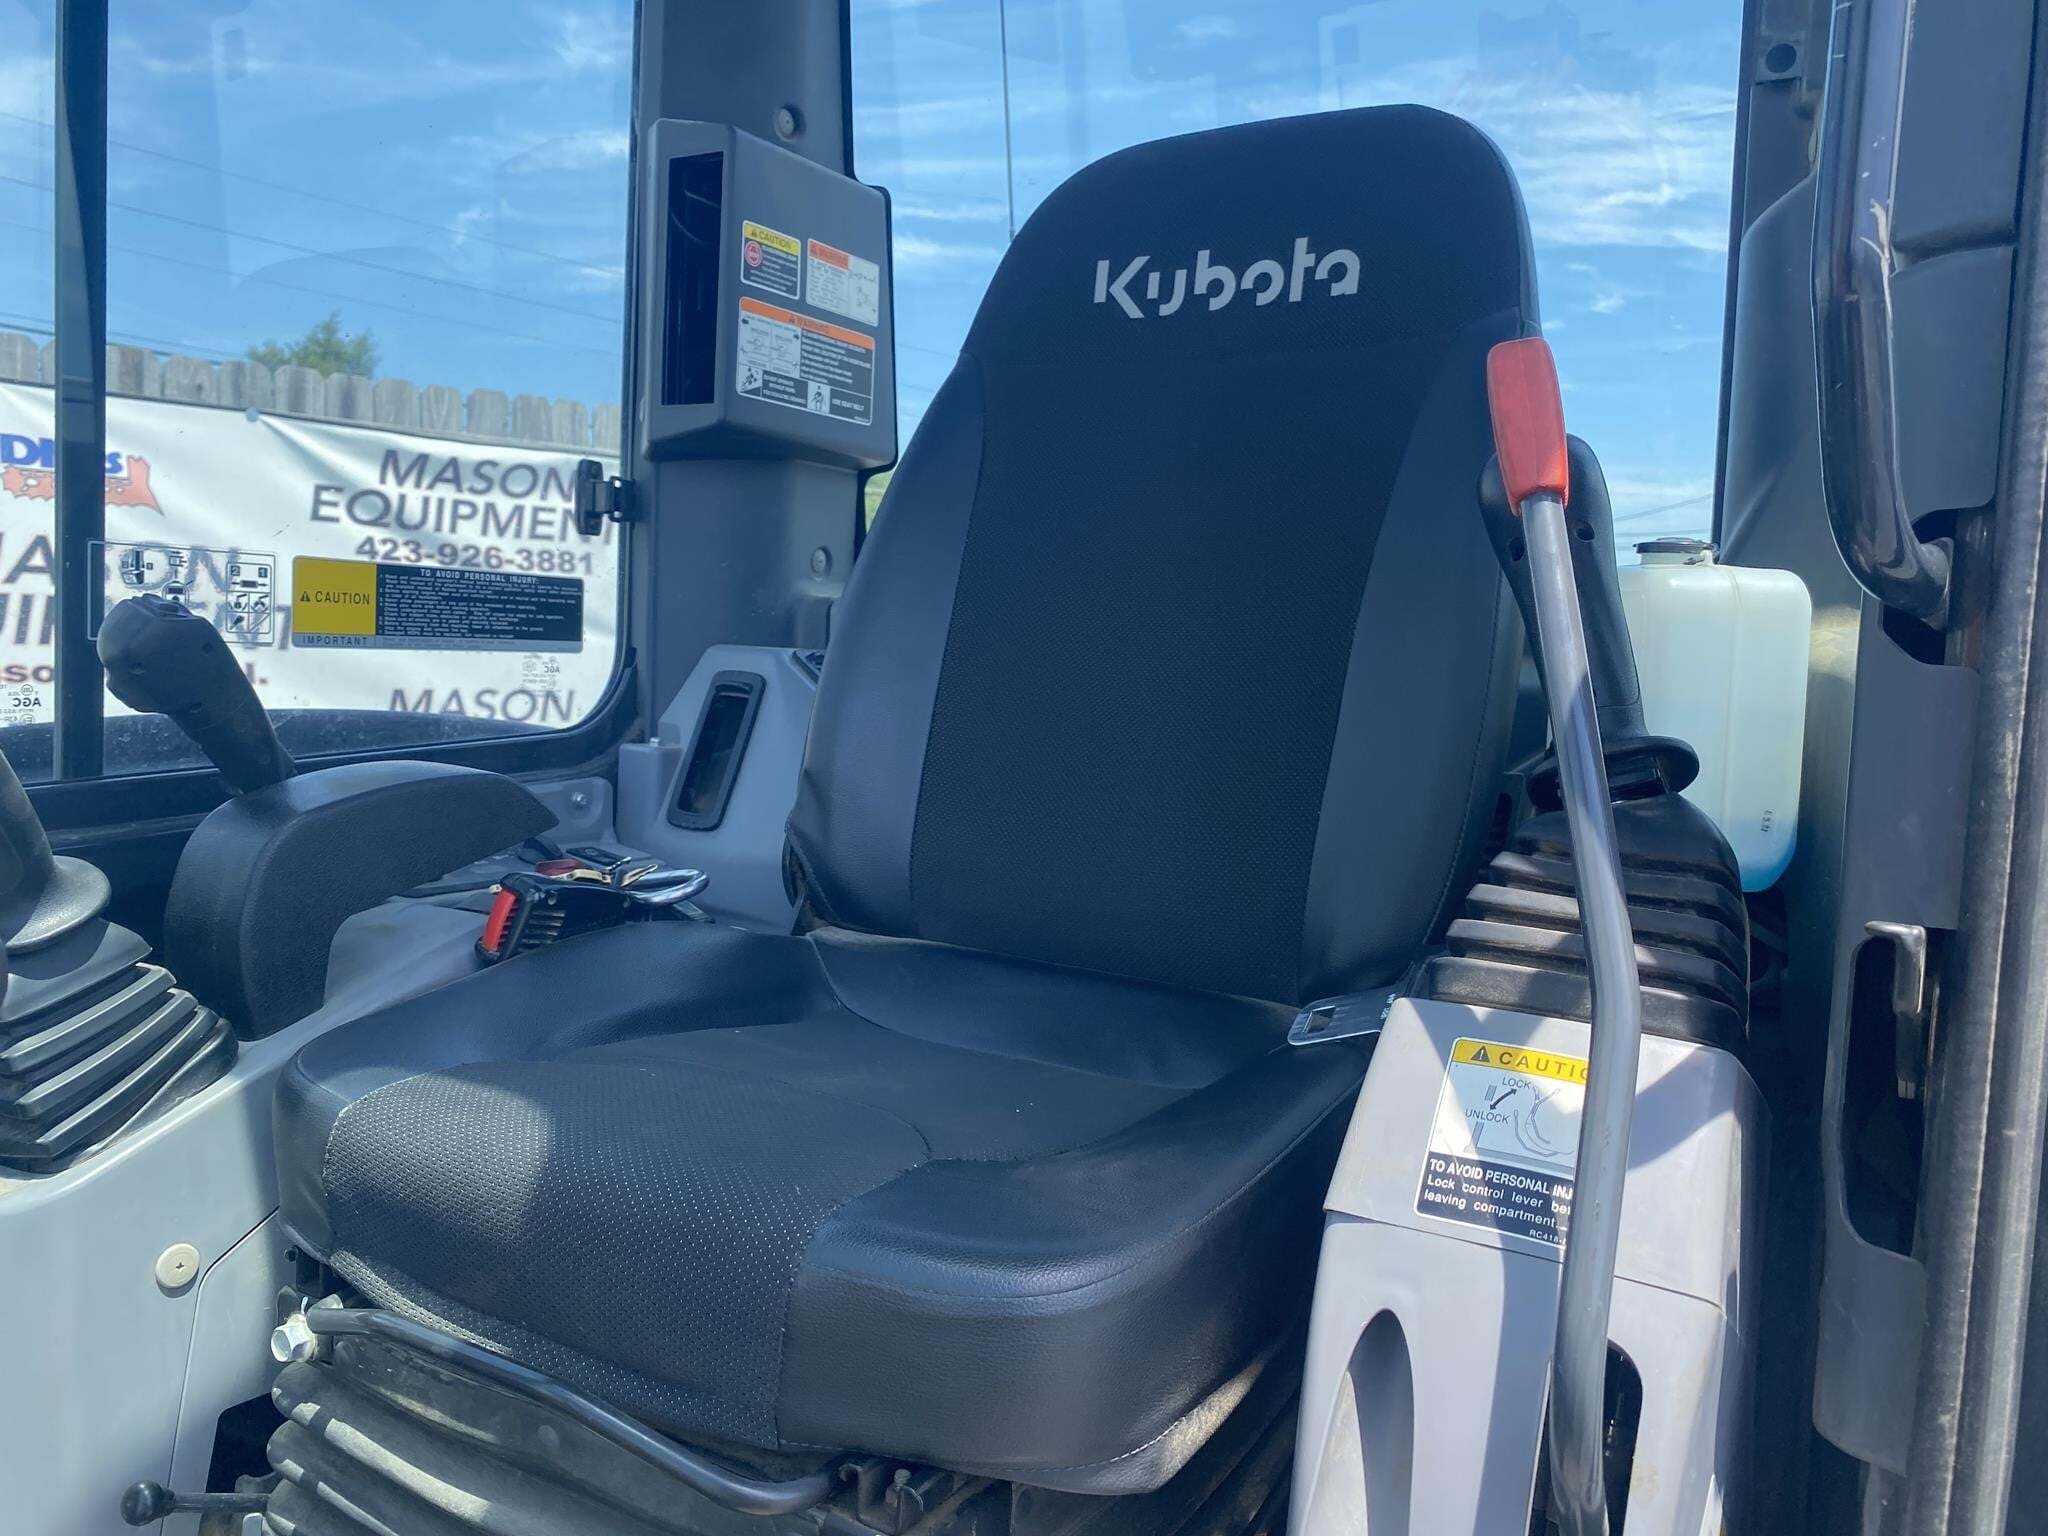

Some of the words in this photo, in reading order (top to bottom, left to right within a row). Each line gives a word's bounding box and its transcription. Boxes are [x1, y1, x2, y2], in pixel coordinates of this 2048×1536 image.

[1094, 236, 1361, 319] Kubota
[378, 449, 579, 502] MASON
[355, 535, 594, 576] 423-926-3881
[420, 569, 431, 577] TO
[436, 570, 460, 579] AVOID
[464, 571, 505, 582] PERSONAL
[315, 591, 370, 605] CAUTION
[302, 635, 368, 646] IMPORTANT
[388, 688, 576, 722] MASON
[1499, 1051, 1588, 1080] CAUTIO
[1502, 1077, 1532, 1089] LOCK
[1465, 1109, 1510, 1124] UNLOCK
[1427, 1174, 1456, 1190] Lock
[1462, 1182, 1504, 1200] control
[1511, 1191, 1544, 1208] lever
[1430, 1159, 1446, 1171] TO
[1446, 1161, 1484, 1180] AVOID
[1485, 1170, 1550, 1194] PERSONAL
[1552, 1184, 1573, 1200] INJ
[1424, 1189, 1467, 1210] leaving
